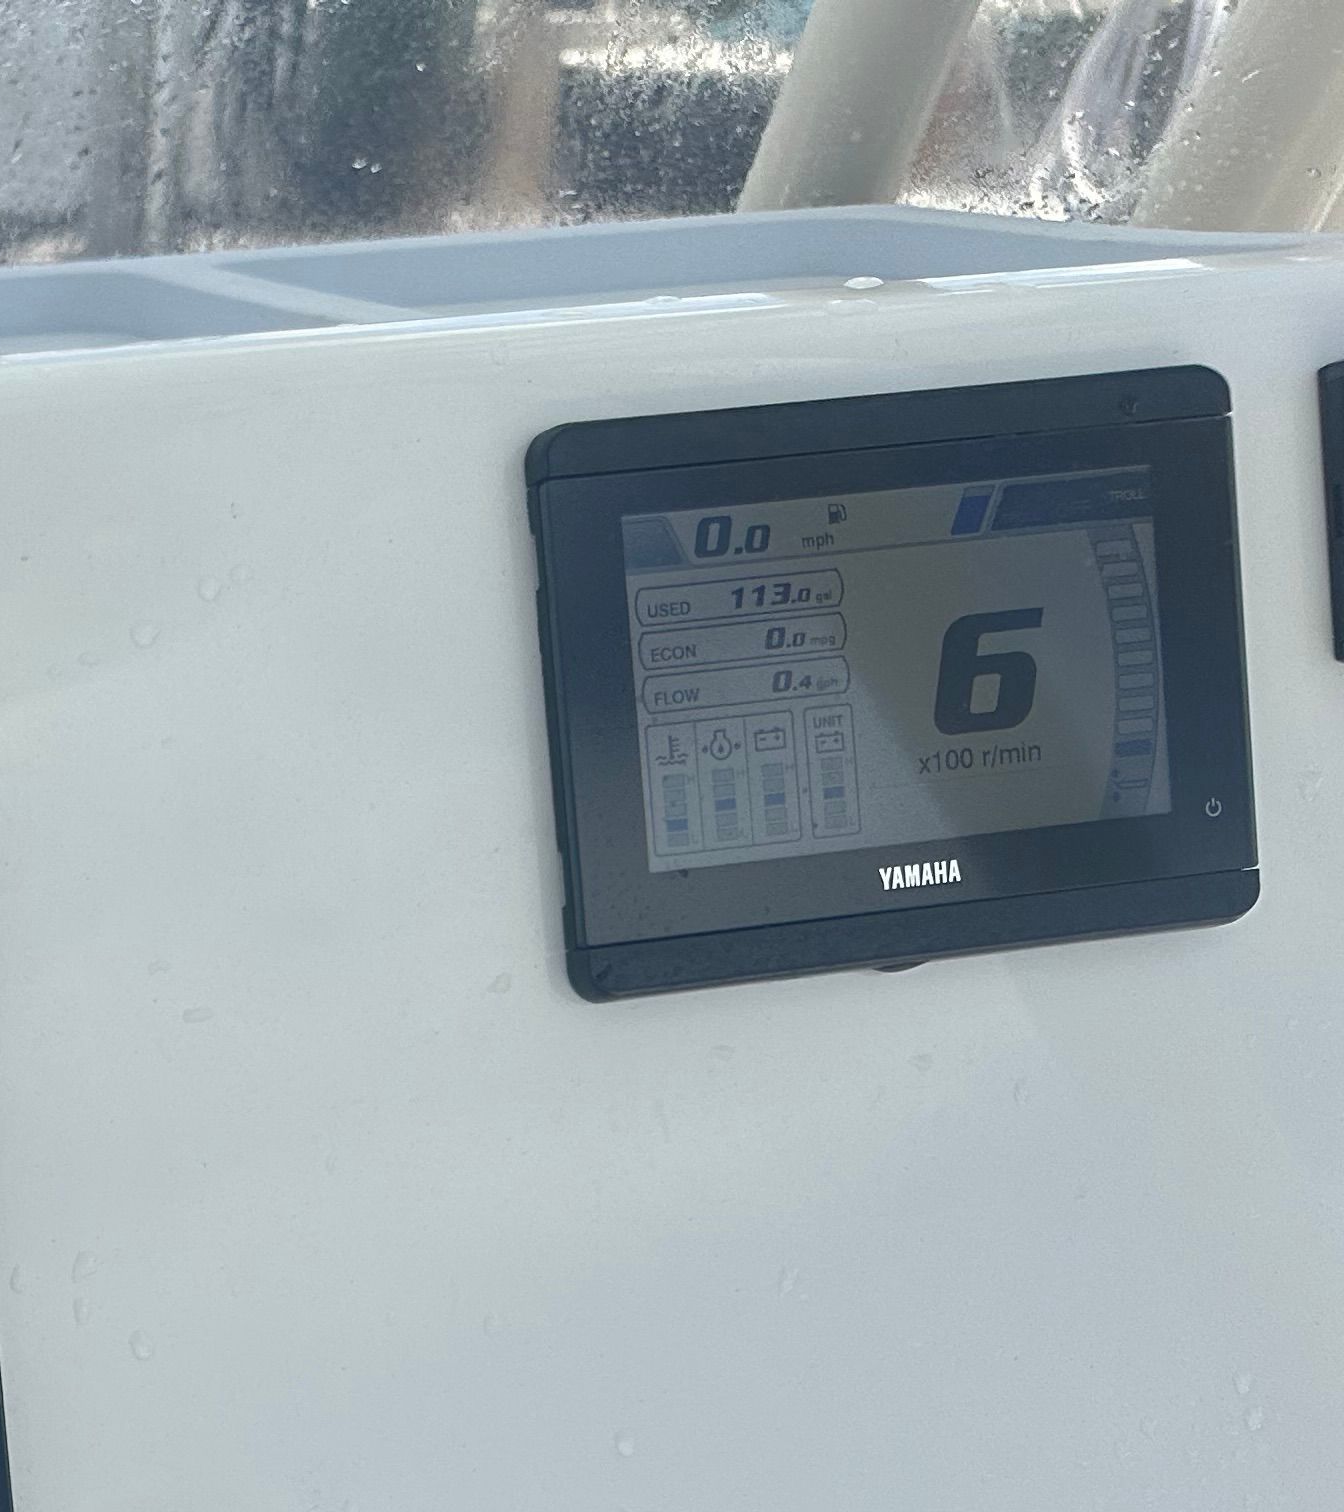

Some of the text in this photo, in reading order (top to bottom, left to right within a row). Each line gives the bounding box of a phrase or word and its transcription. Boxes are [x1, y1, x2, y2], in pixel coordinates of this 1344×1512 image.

[694, 515, 835, 558] 0.0 mph
[647, 602, 691, 618] USED
[731, 583, 811, 609] 113.0
[651, 644, 697, 662] ECON
[765, 627, 806, 650] 0.0
[654, 688, 700, 706] FLOW
[772, 670, 812, 693] 0.4
[934, 607, 1044, 736] 6
[812, 715, 844, 728] UNIT
[919, 742, 1041, 775] x100 r/min
[879, 859, 961, 891] YAMAHA
